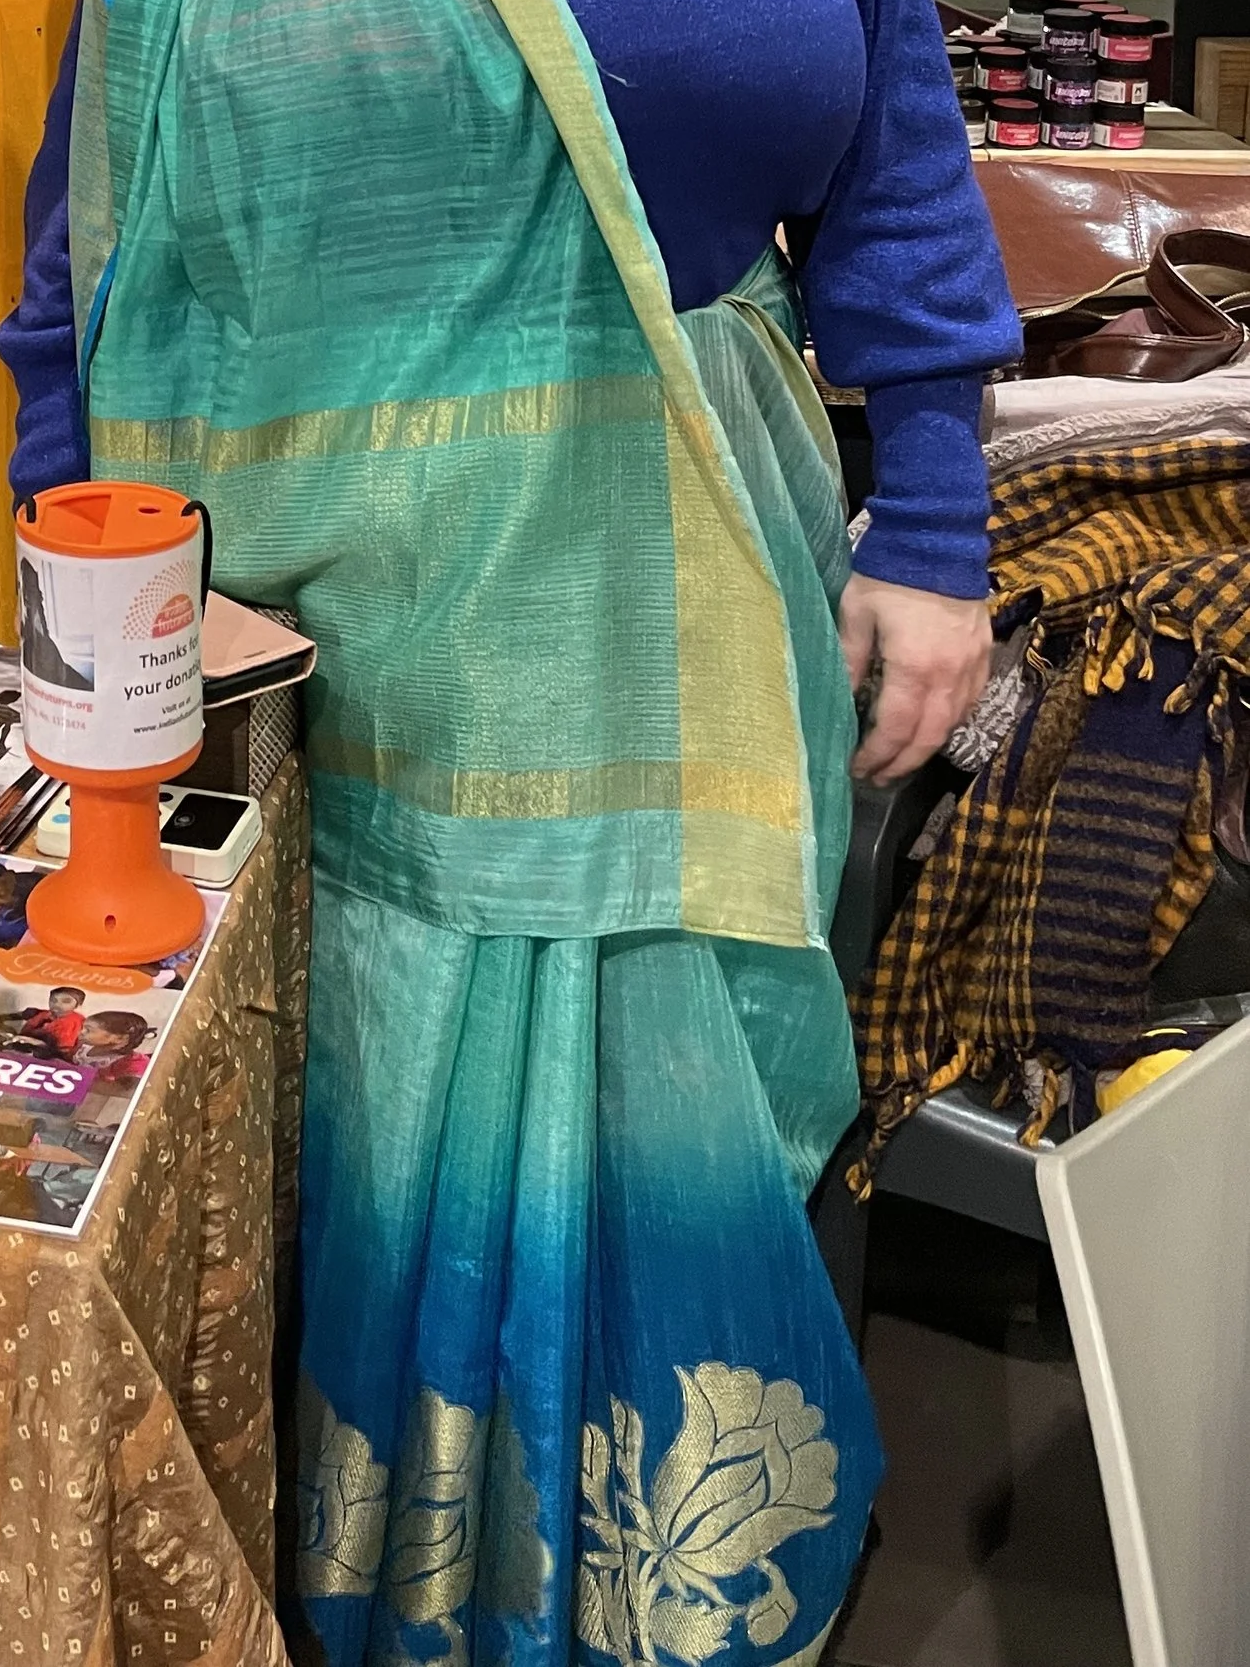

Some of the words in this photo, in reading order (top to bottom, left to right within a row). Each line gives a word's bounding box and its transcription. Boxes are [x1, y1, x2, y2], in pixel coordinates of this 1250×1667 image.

[139, 643, 187, 669] Thanks
[124, 680, 162, 701] your
[6, 951, 136, 990] Futures
